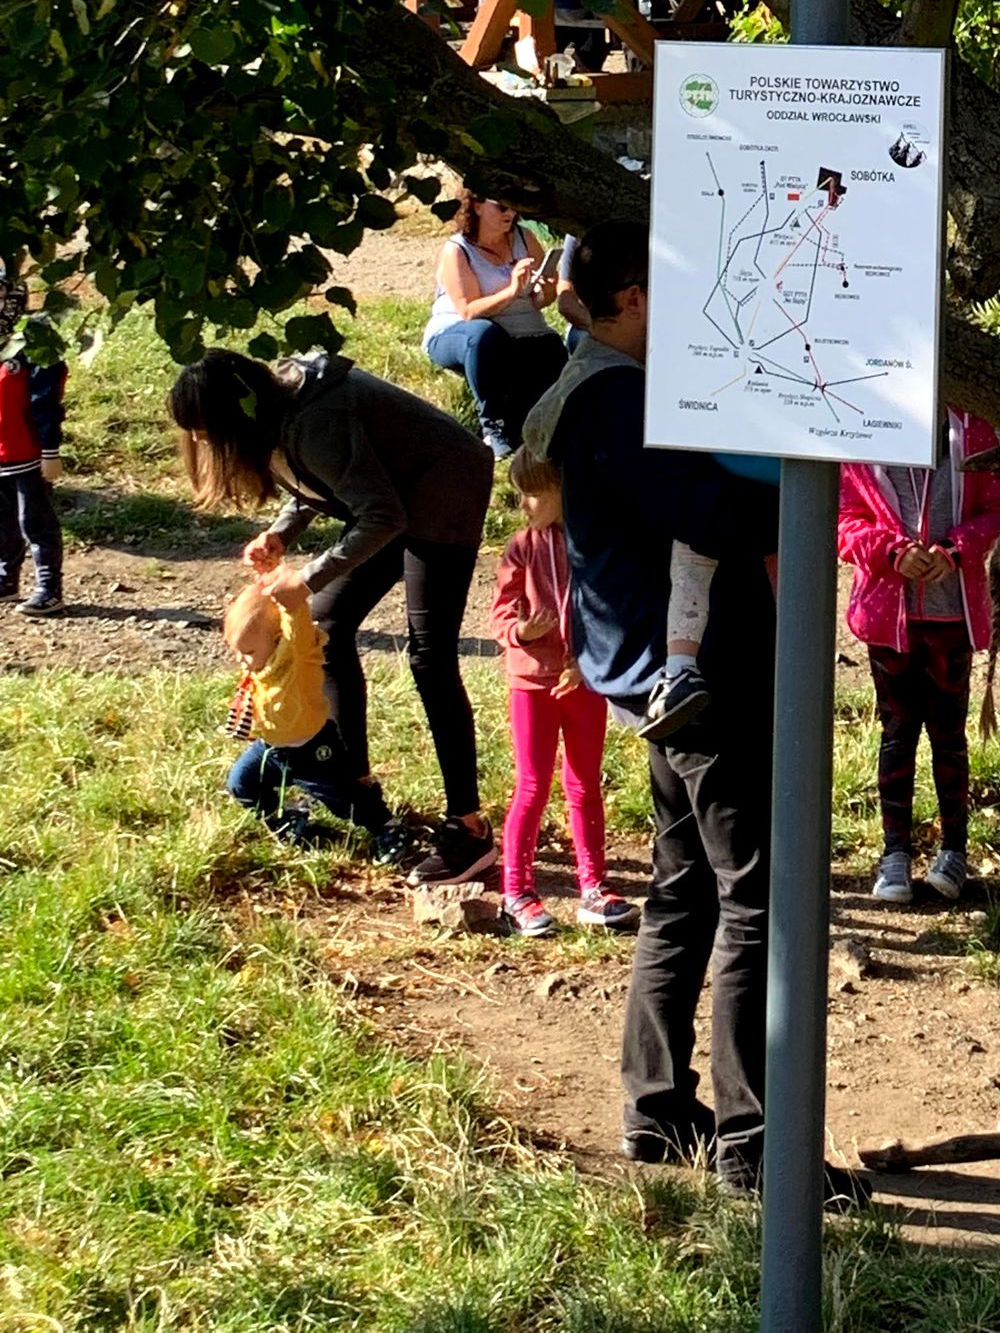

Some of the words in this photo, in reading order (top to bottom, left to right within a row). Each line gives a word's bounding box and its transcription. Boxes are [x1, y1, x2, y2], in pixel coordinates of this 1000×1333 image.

[750, 76, 801, 89] POLSKIE
[805, 77, 900, 92] TOWARZYSTWO
[729, 89, 921, 107] TURYSTYCZNO-KRAJOZNAWCZE
[766, 110, 809, 121] ODDZIAŁ
[812, 112, 881, 124] WROCŁAWSKI
[850, 169, 895, 183] SOBÓTKA
